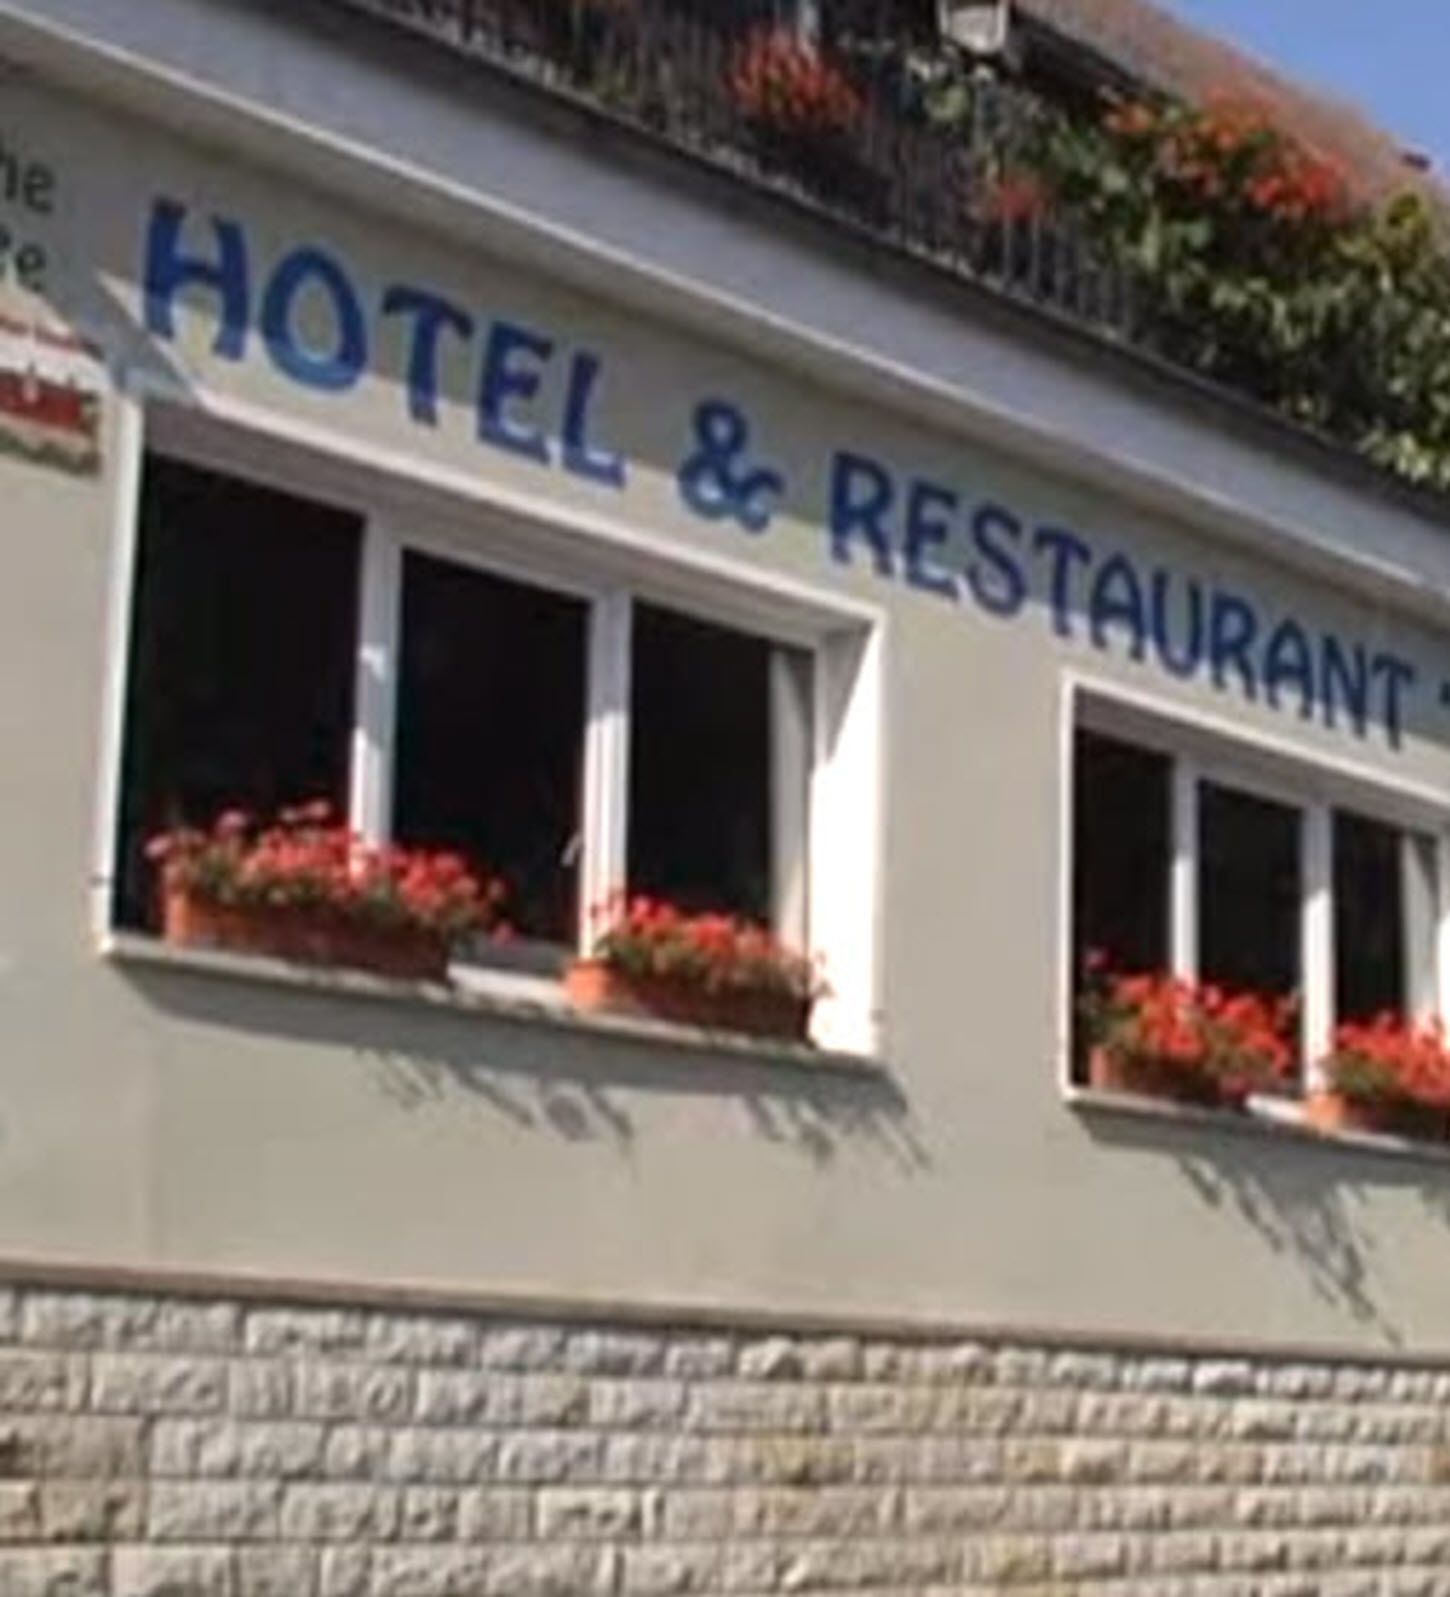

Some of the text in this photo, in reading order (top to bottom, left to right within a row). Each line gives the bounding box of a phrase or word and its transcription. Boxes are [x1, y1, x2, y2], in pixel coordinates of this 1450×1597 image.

[144, 194, 628, 488] HOTEL
[678, 399, 785, 532] &
[830, 449, 1415, 750] RESTAURANT
